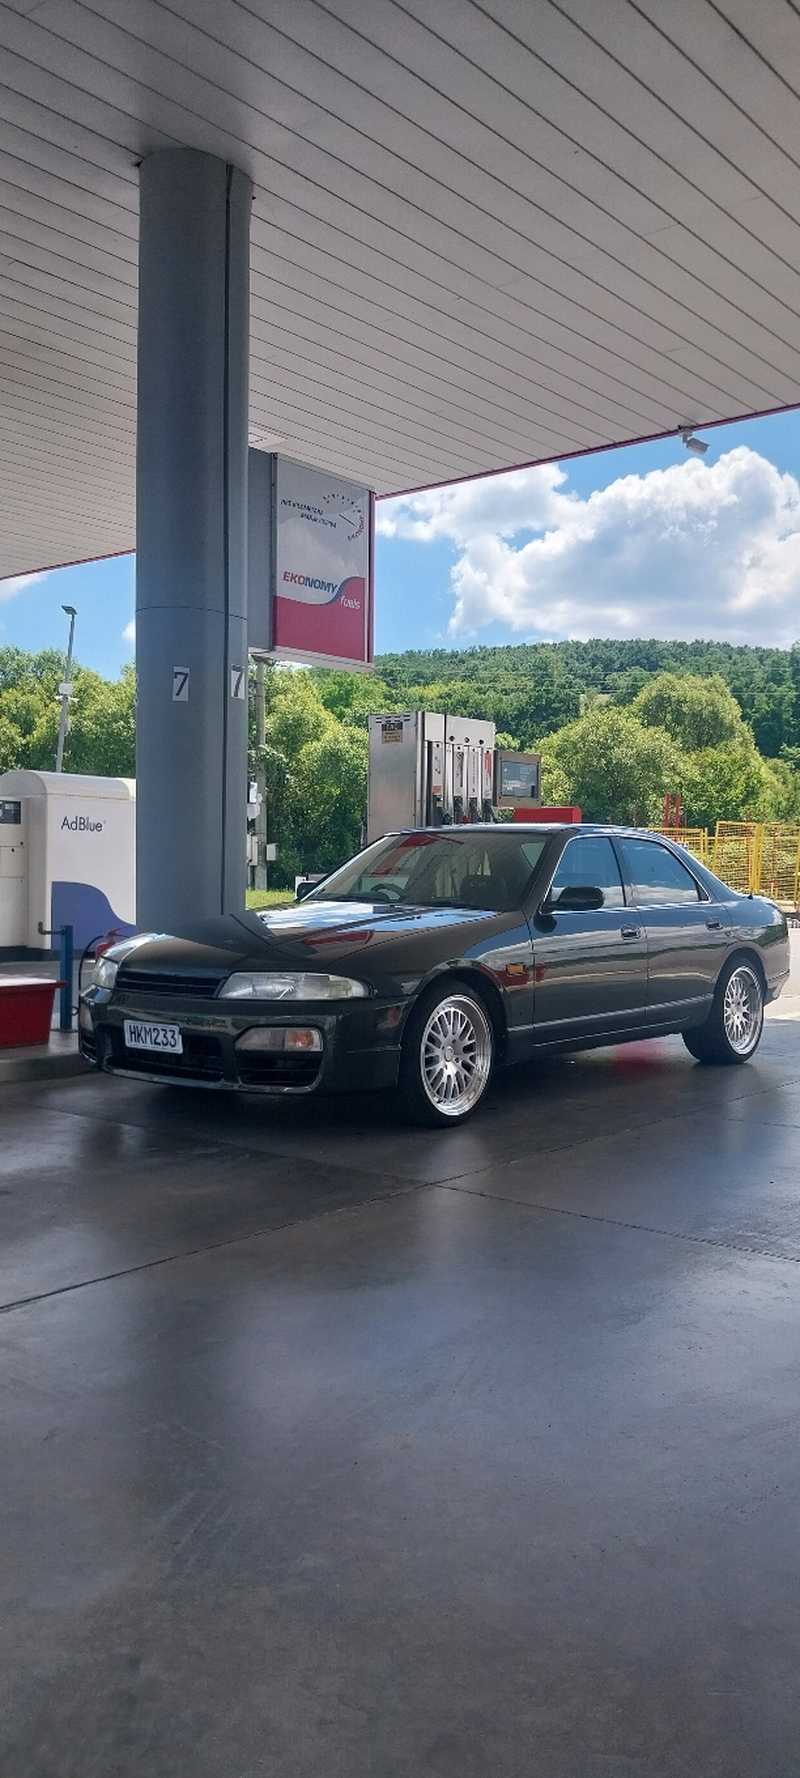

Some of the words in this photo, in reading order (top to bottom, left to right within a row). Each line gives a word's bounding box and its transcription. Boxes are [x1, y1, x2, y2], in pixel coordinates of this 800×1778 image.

[283, 571, 338, 593] EKONOMY
[174, 672, 189, 696] 7
[232, 665, 244, 697] 7
[60, 816, 103, 832] AdBlue
[128, 1024, 177, 1048] HKM233
